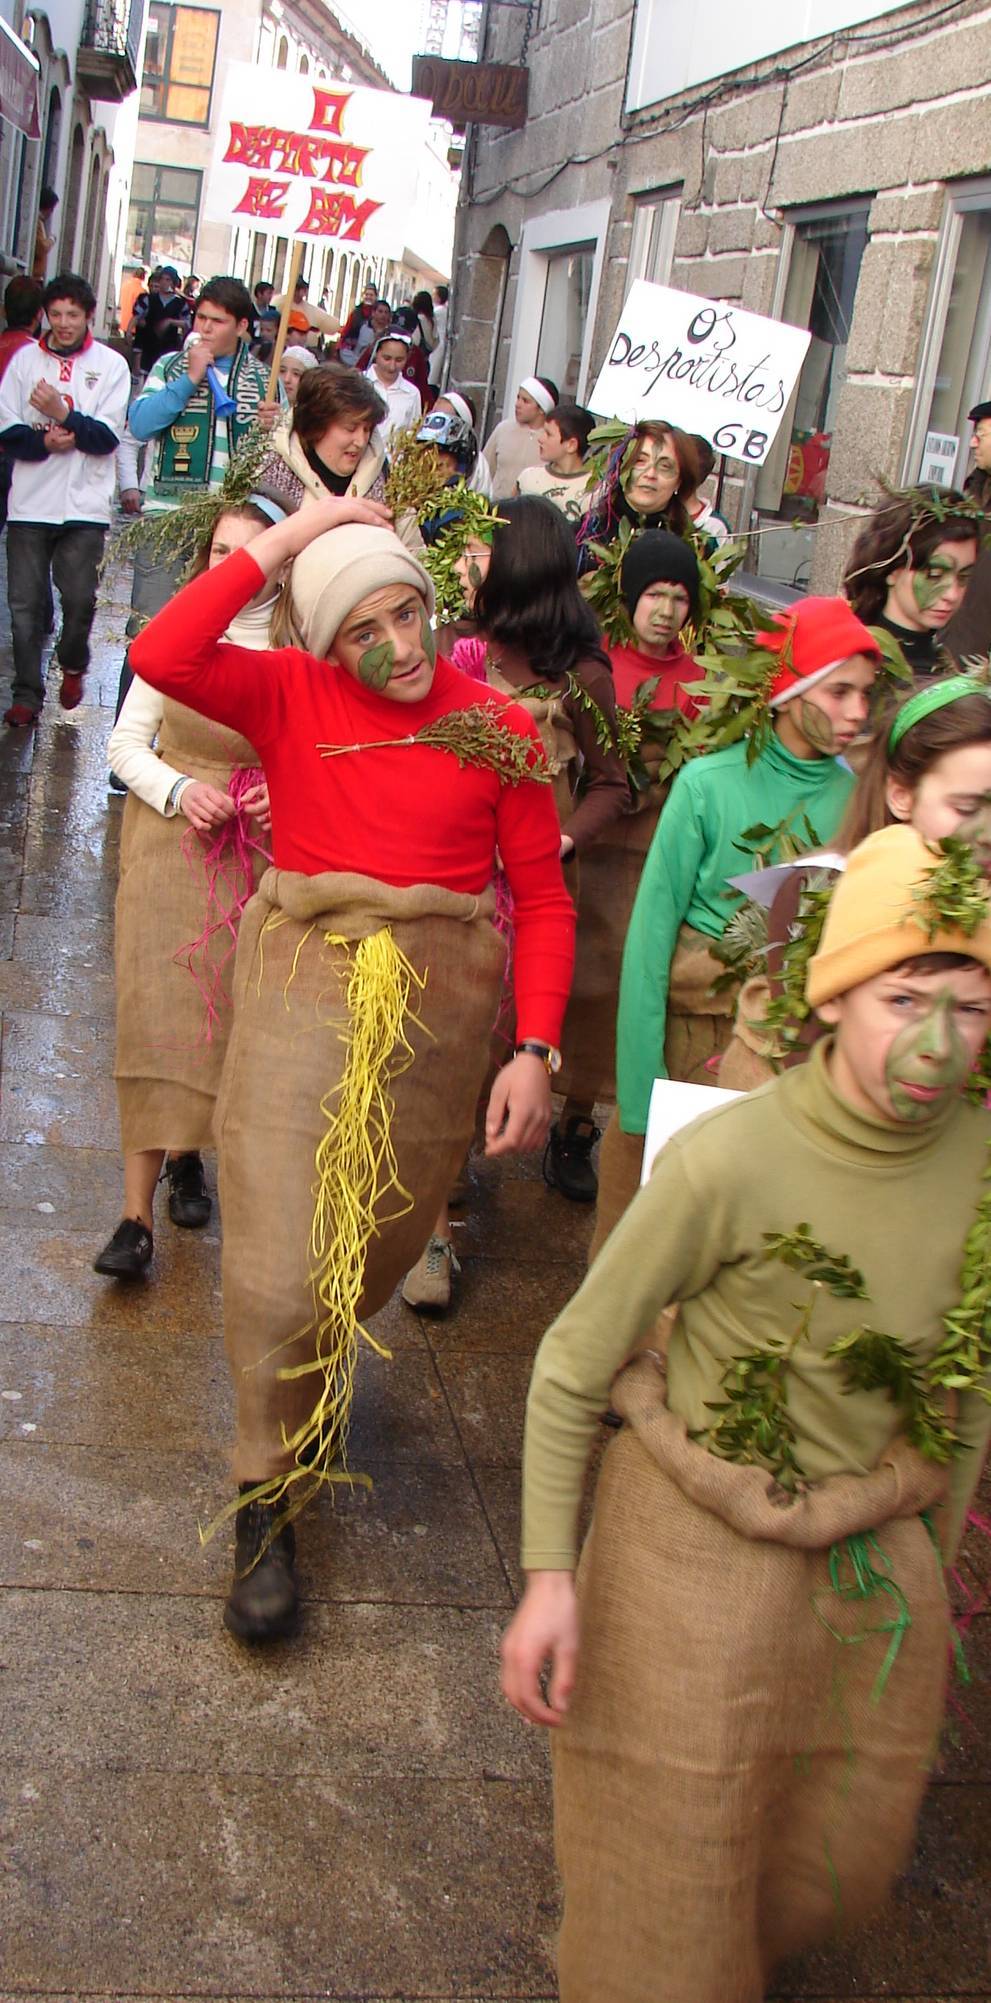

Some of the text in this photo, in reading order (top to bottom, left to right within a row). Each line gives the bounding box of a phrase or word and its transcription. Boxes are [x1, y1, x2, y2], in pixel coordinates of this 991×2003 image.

[308, 86, 355, 137] O
[222, 121, 374, 188] DESPORTO
[232, 176, 386, 242] FAZ BEM
[609, 333, 785, 412] Desportistas
